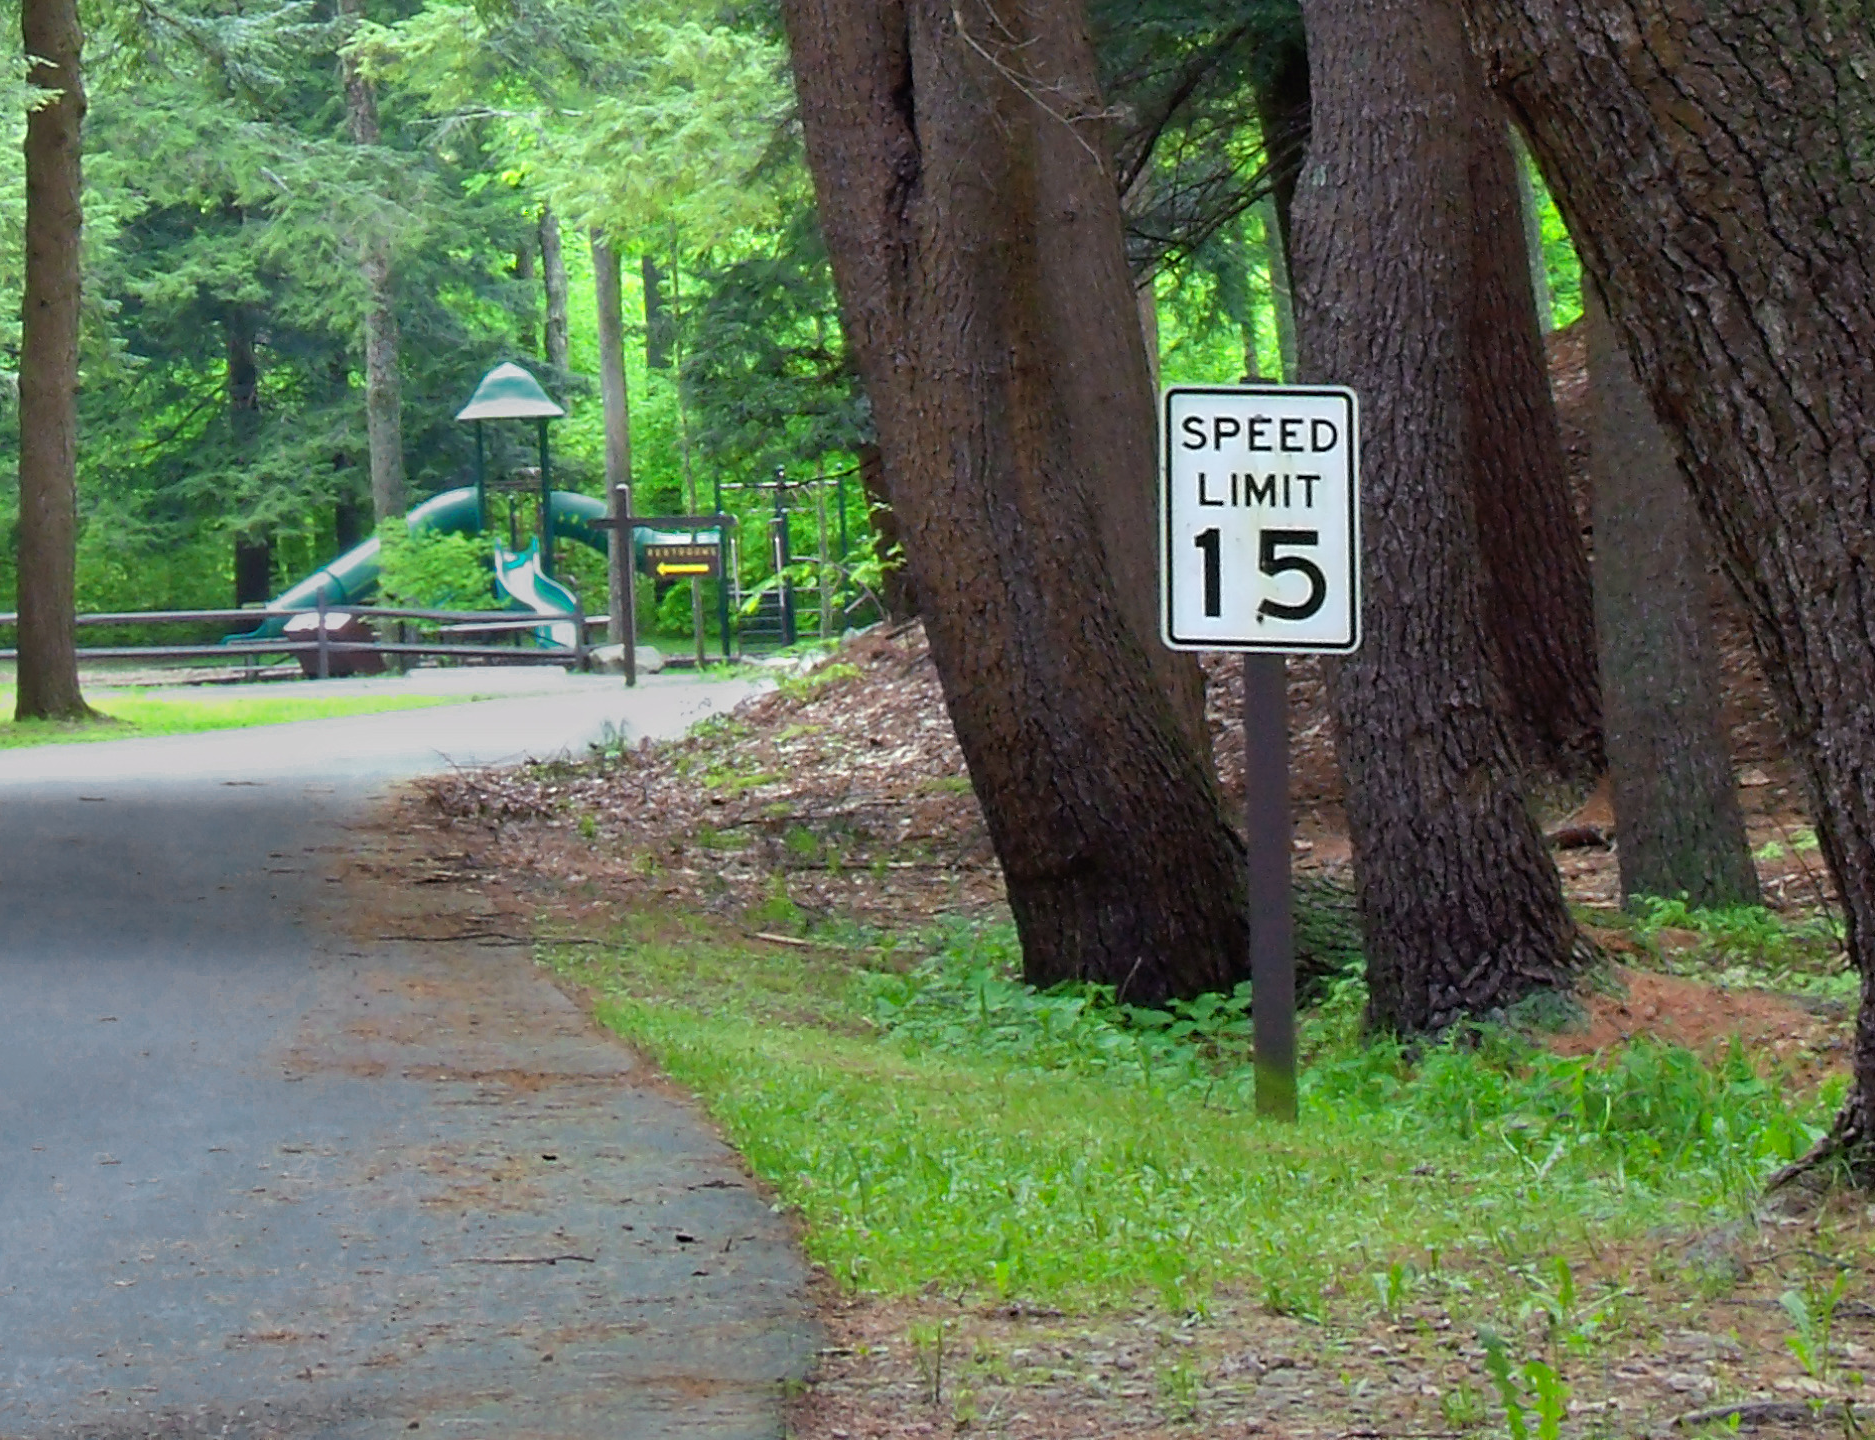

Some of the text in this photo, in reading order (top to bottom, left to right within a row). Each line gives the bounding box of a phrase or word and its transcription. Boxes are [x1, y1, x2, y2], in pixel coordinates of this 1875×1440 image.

[1182, 416, 1338, 453] SPEED
[1198, 472, 1321, 508] LIMIT
[1194, 527, 1327, 622] 15
